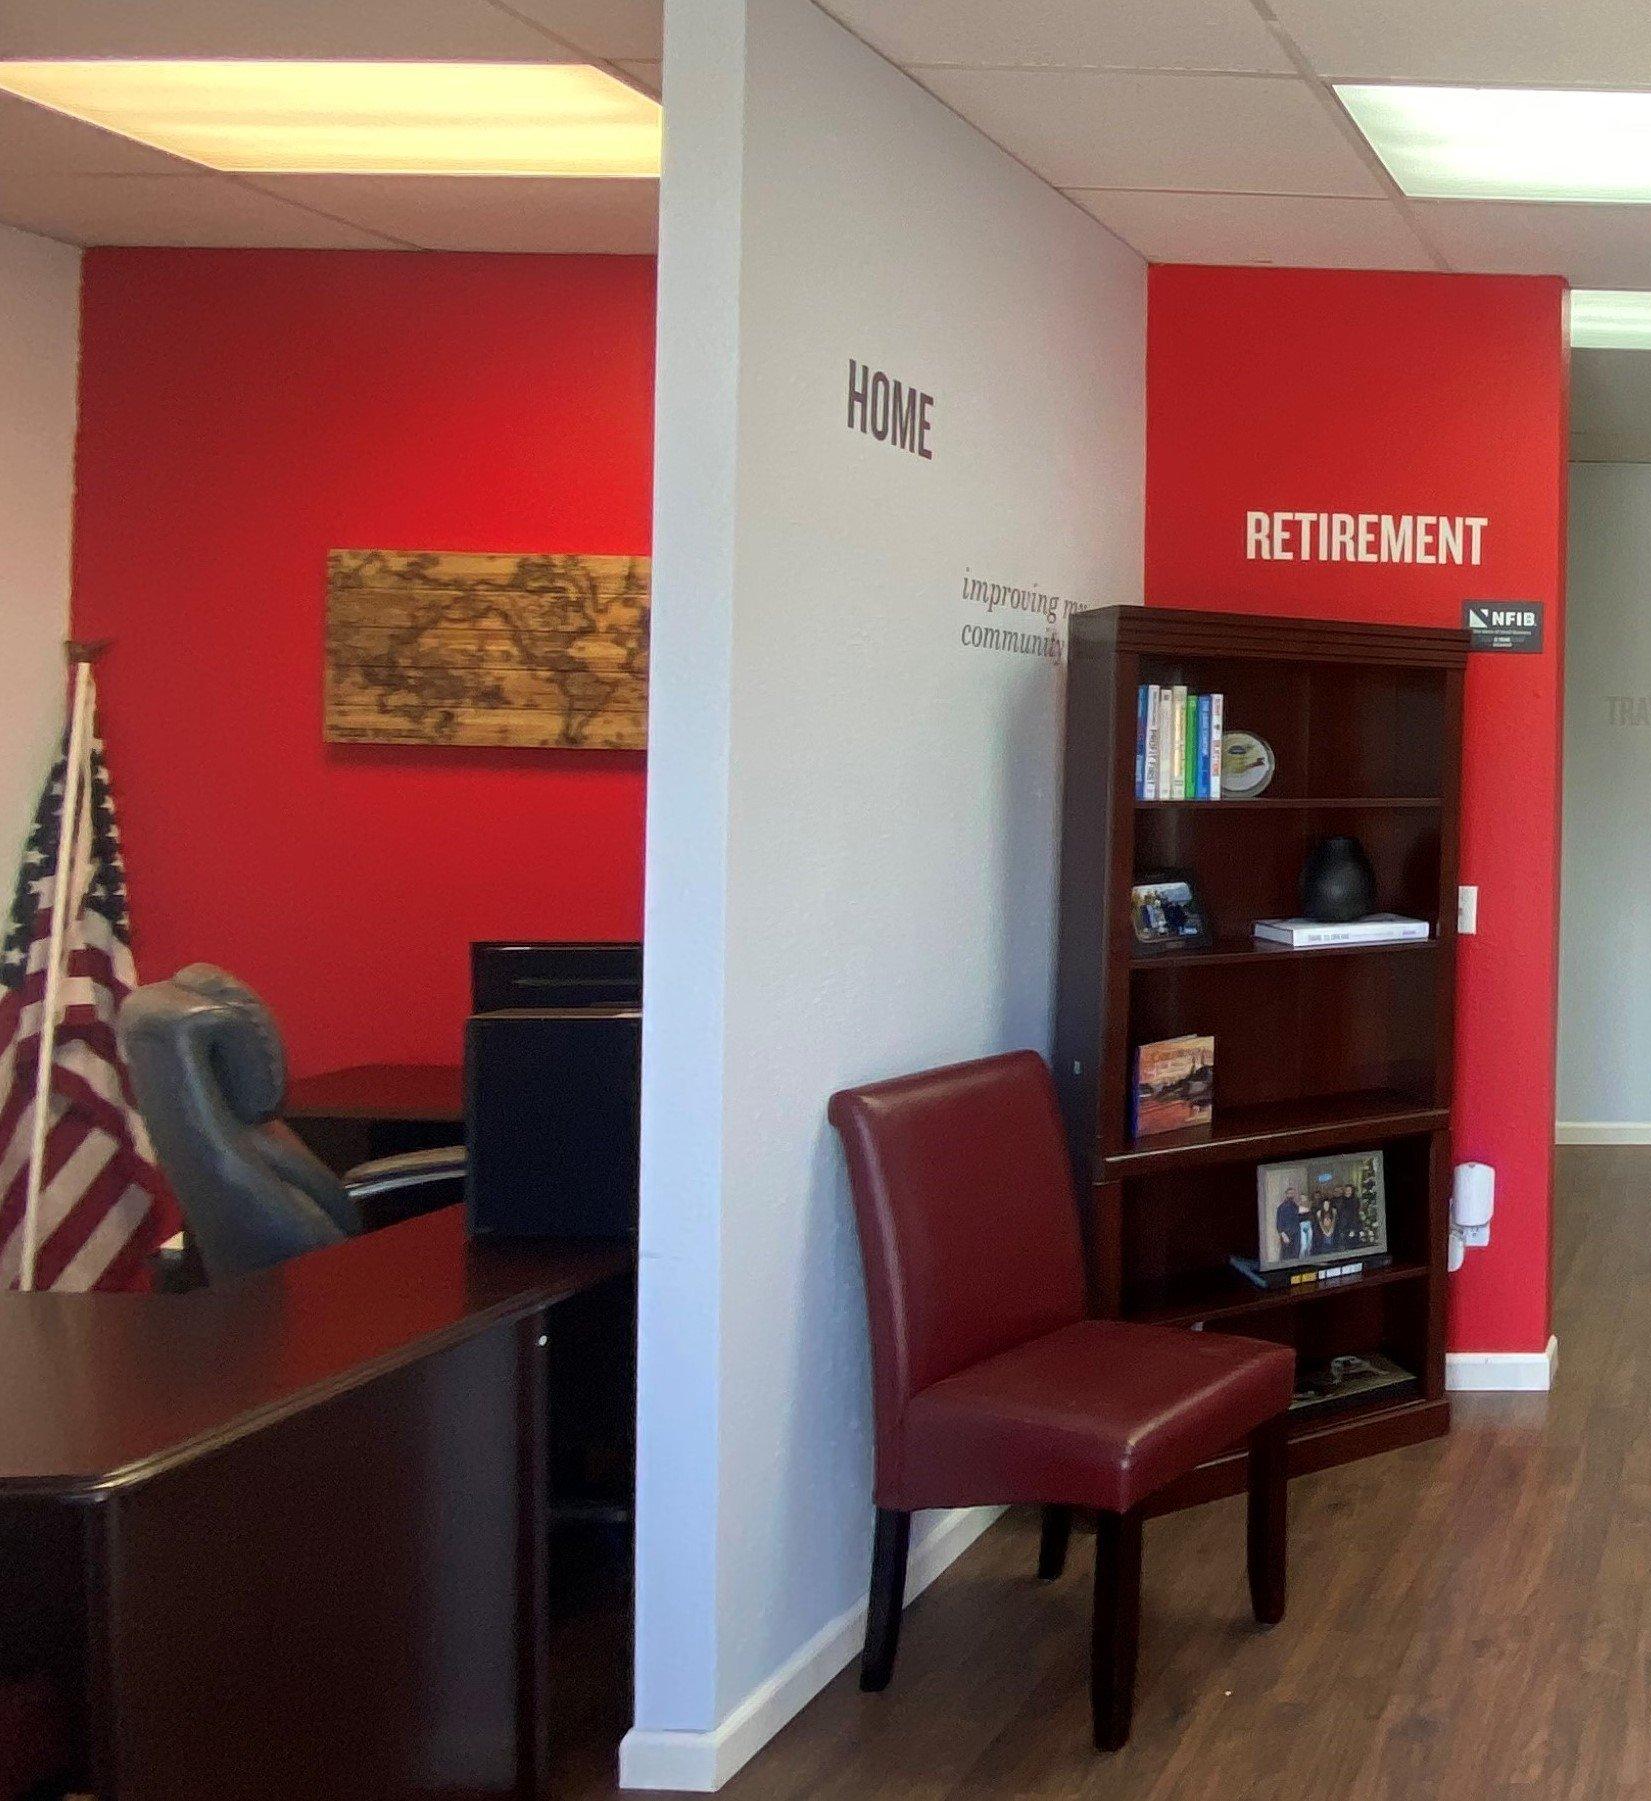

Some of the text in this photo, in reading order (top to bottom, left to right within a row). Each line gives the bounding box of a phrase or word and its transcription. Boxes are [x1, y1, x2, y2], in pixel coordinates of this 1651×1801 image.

[847, 358, 934, 460] HOME
[1246, 511, 1489, 566] RETIREMENT
[962, 566, 1060, 624] improving
[1492, 611, 1536, 627] NFIB
